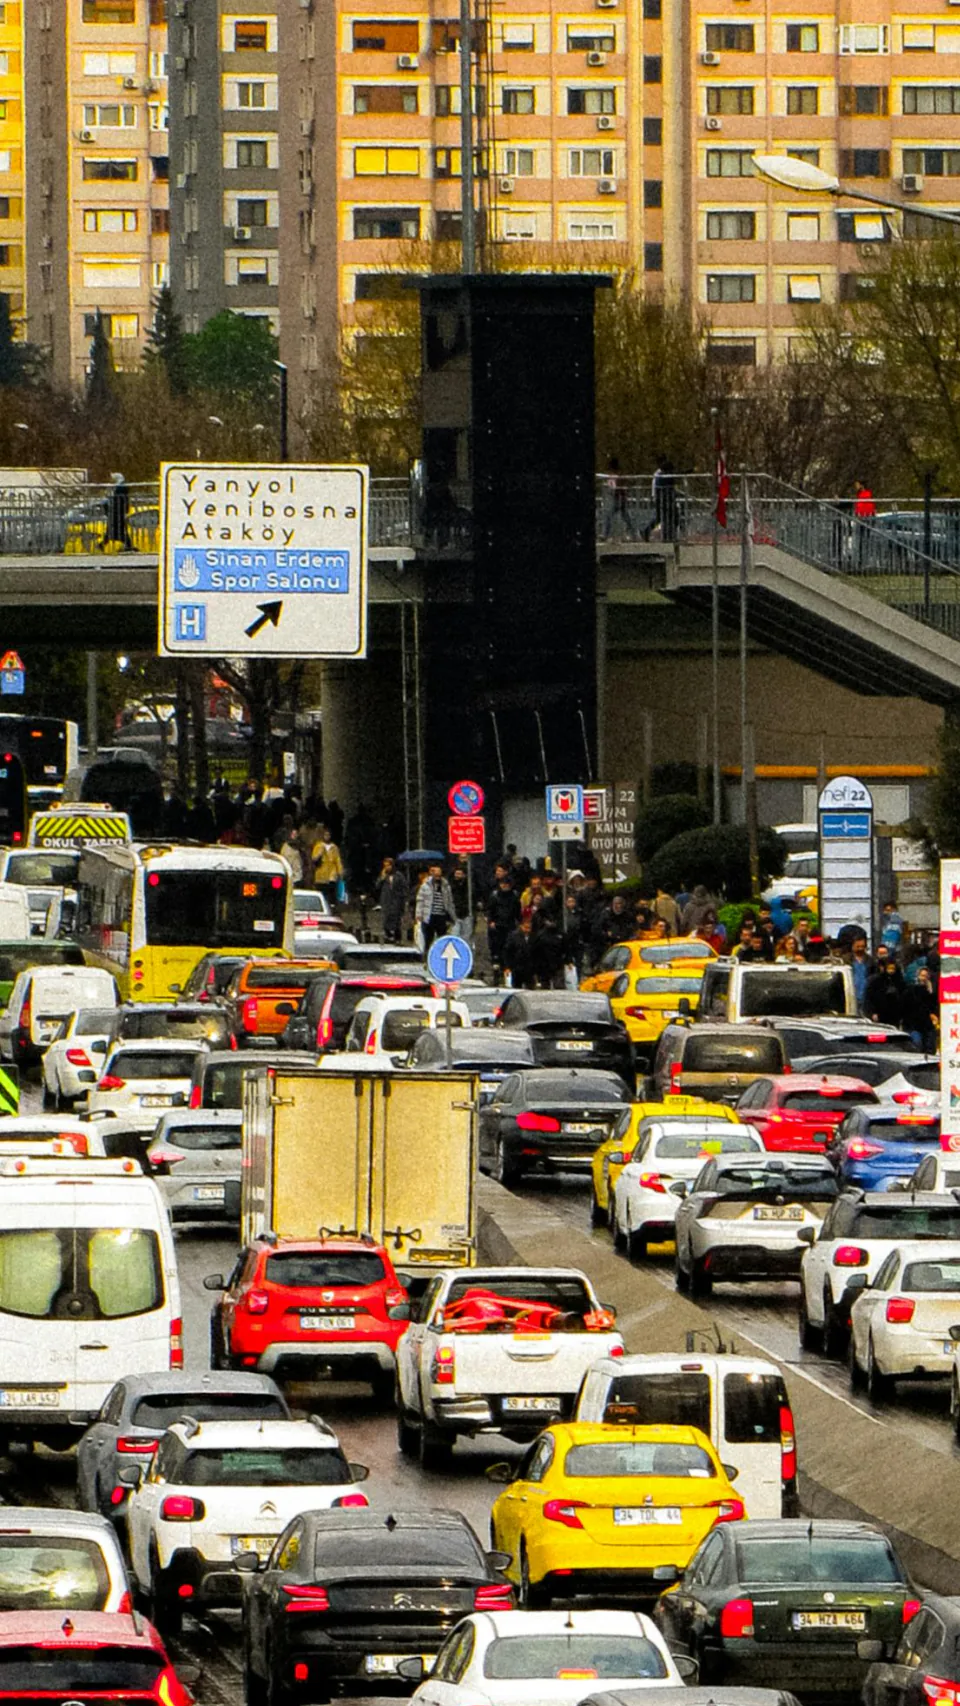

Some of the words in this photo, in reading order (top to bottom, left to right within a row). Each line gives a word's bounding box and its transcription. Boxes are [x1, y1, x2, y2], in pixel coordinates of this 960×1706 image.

[182, 475, 296, 497] Yanyol
[182, 499, 358, 519] Yenibosna
[181, 522, 295, 545] Ataköy
[206, 551, 267, 567] Sinan
[275, 552, 345, 568] Erdem
[211, 573, 260, 590] Spor
[267, 573, 340, 589] Salonu
[181, 608, 200, 636] H
[43, 837, 75, 847] OKUL
[620, 1509, 632, 1520] 34
[798, 1613, 812, 1625] 34
[819, 1612, 838, 1625] HZA
[844, 1612, 864, 1625] 464
